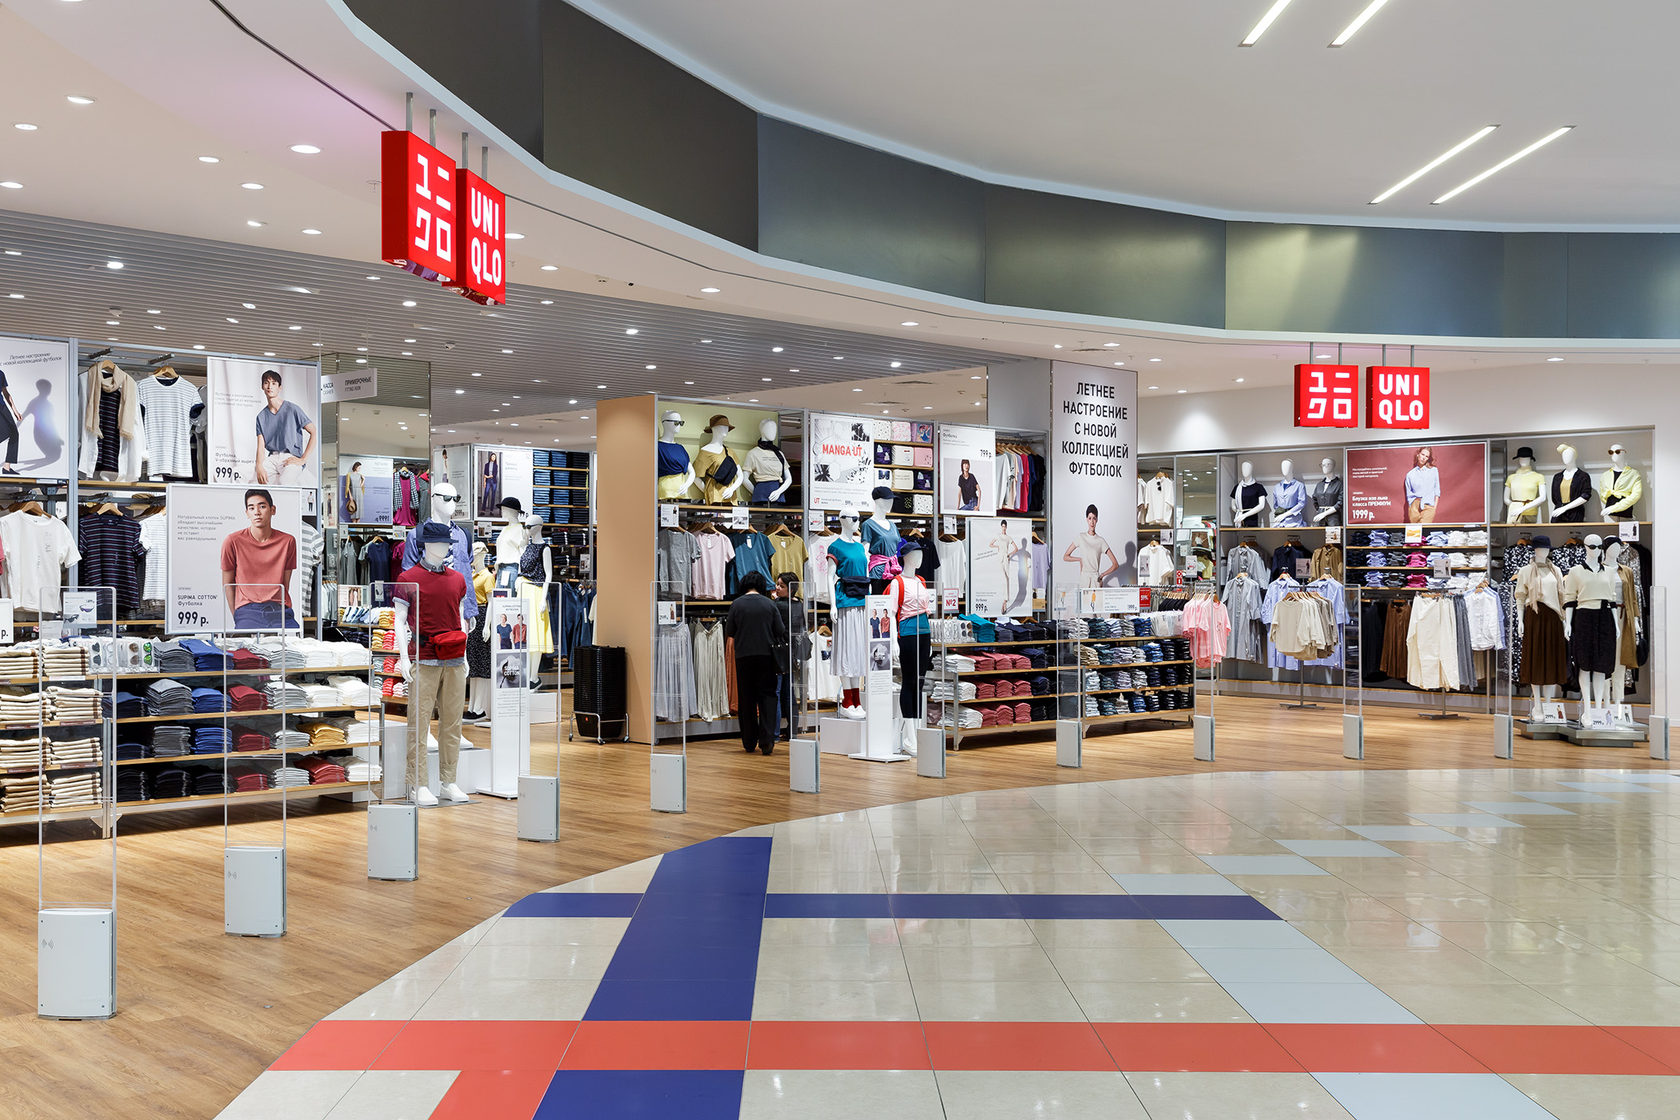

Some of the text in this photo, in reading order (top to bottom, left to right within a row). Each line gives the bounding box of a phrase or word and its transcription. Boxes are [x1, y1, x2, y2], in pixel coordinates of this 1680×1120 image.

[416, 153, 451, 212] ユニ
[471, 187, 499, 240] UNI
[414, 206, 451, 262] クロ
[471, 237, 502, 286] QLO
[1076, 382, 1115, 399] ЛЕТНЕЕ
[1309, 372, 1352, 394] ユニ
[1378, 374, 1420, 396] UNI
[1063, 400, 1128, 420] НАСТРОЕНИЕ
[1307, 398, 1352, 420] クロ
[1378, 399, 1424, 424] QLO
[1074, 422, 1117, 438] С НОВОЙ
[822, 444, 862, 456] MANGA UT
[1062, 441, 1129, 459] КОЛЛЕКЦИЕЙ
[216, 466, 232, 478] 999
[1069, 461, 1122, 478] ФУТБОЛОК
[1352, 510, 1368, 519] 1999
[178, 611, 209, 627] 999 р.
